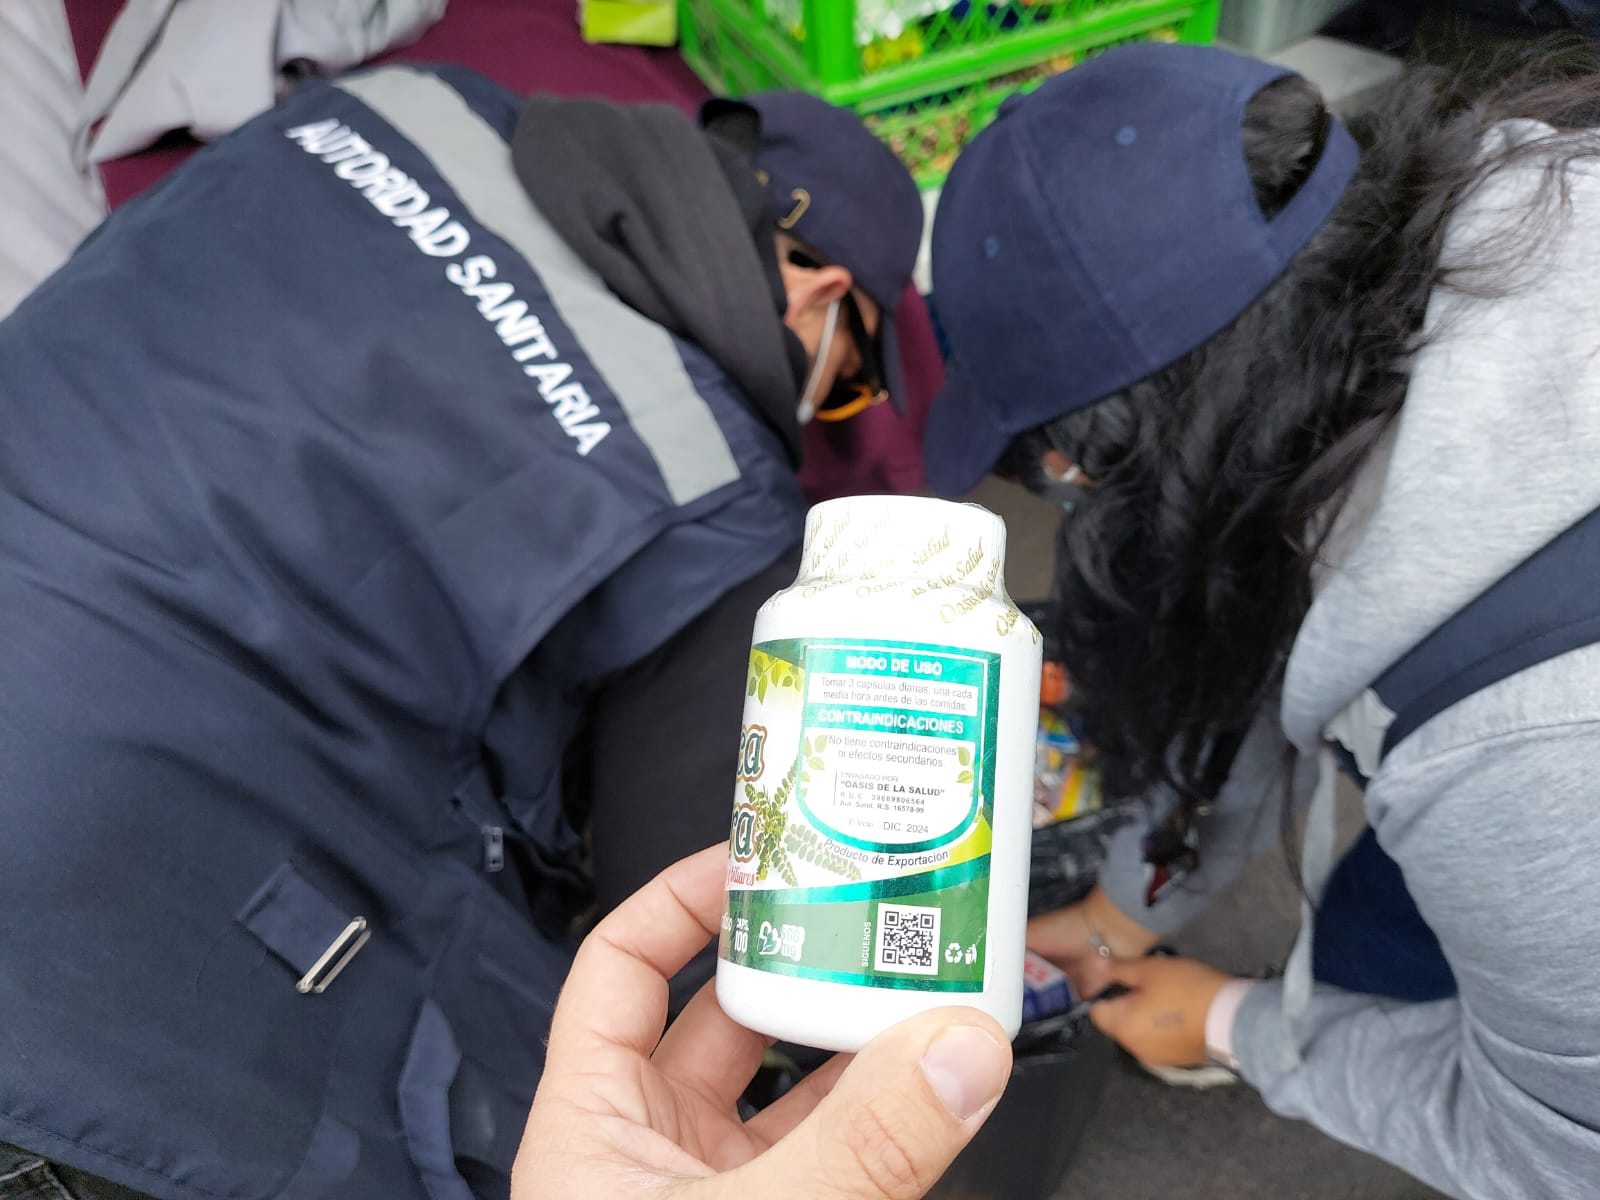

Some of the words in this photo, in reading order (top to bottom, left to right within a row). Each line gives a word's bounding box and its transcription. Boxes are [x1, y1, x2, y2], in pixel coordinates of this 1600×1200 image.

[284, 117, 470, 258] AUTORIDAD
[445, 254, 611, 456] SANITARIA
[846, 655, 887, 671] MODO
[891, 658, 910, 673] DE
[913, 660, 943, 676] USO
[821, 676, 846, 688] Tomar
[848, 678, 854, 688] 3
[856, 679, 896, 692] capsulas
[899, 682, 931, 695] diarias,
[933, 687, 950, 697] una
[952, 688, 972, 700] cada
[823, 690, 849, 700] media
[851, 690, 871, 701] hora
[873, 694, 898, 704] antes
[900, 694, 912, 704] de
[914, 696, 928, 706] las
[930, 698, 969, 711] comidas.
[818, 709, 963, 734] CONTRAINDICACIONES
[828, 735, 842, 745] No
[844, 736, 867, 748] tiene
[869, 739, 957, 756] contraindicaciones
[838, 749, 846, 758] ni
[848, 749, 883, 762] efectos
[877, 783, 890, 792] DE
[893, 785, 906, 793] LA
[906, 823, 929, 834] 2024
[823, 838, 869, 863] Producto
[871, 854, 885, 865] de
[887, 850, 949, 869] Exportación
